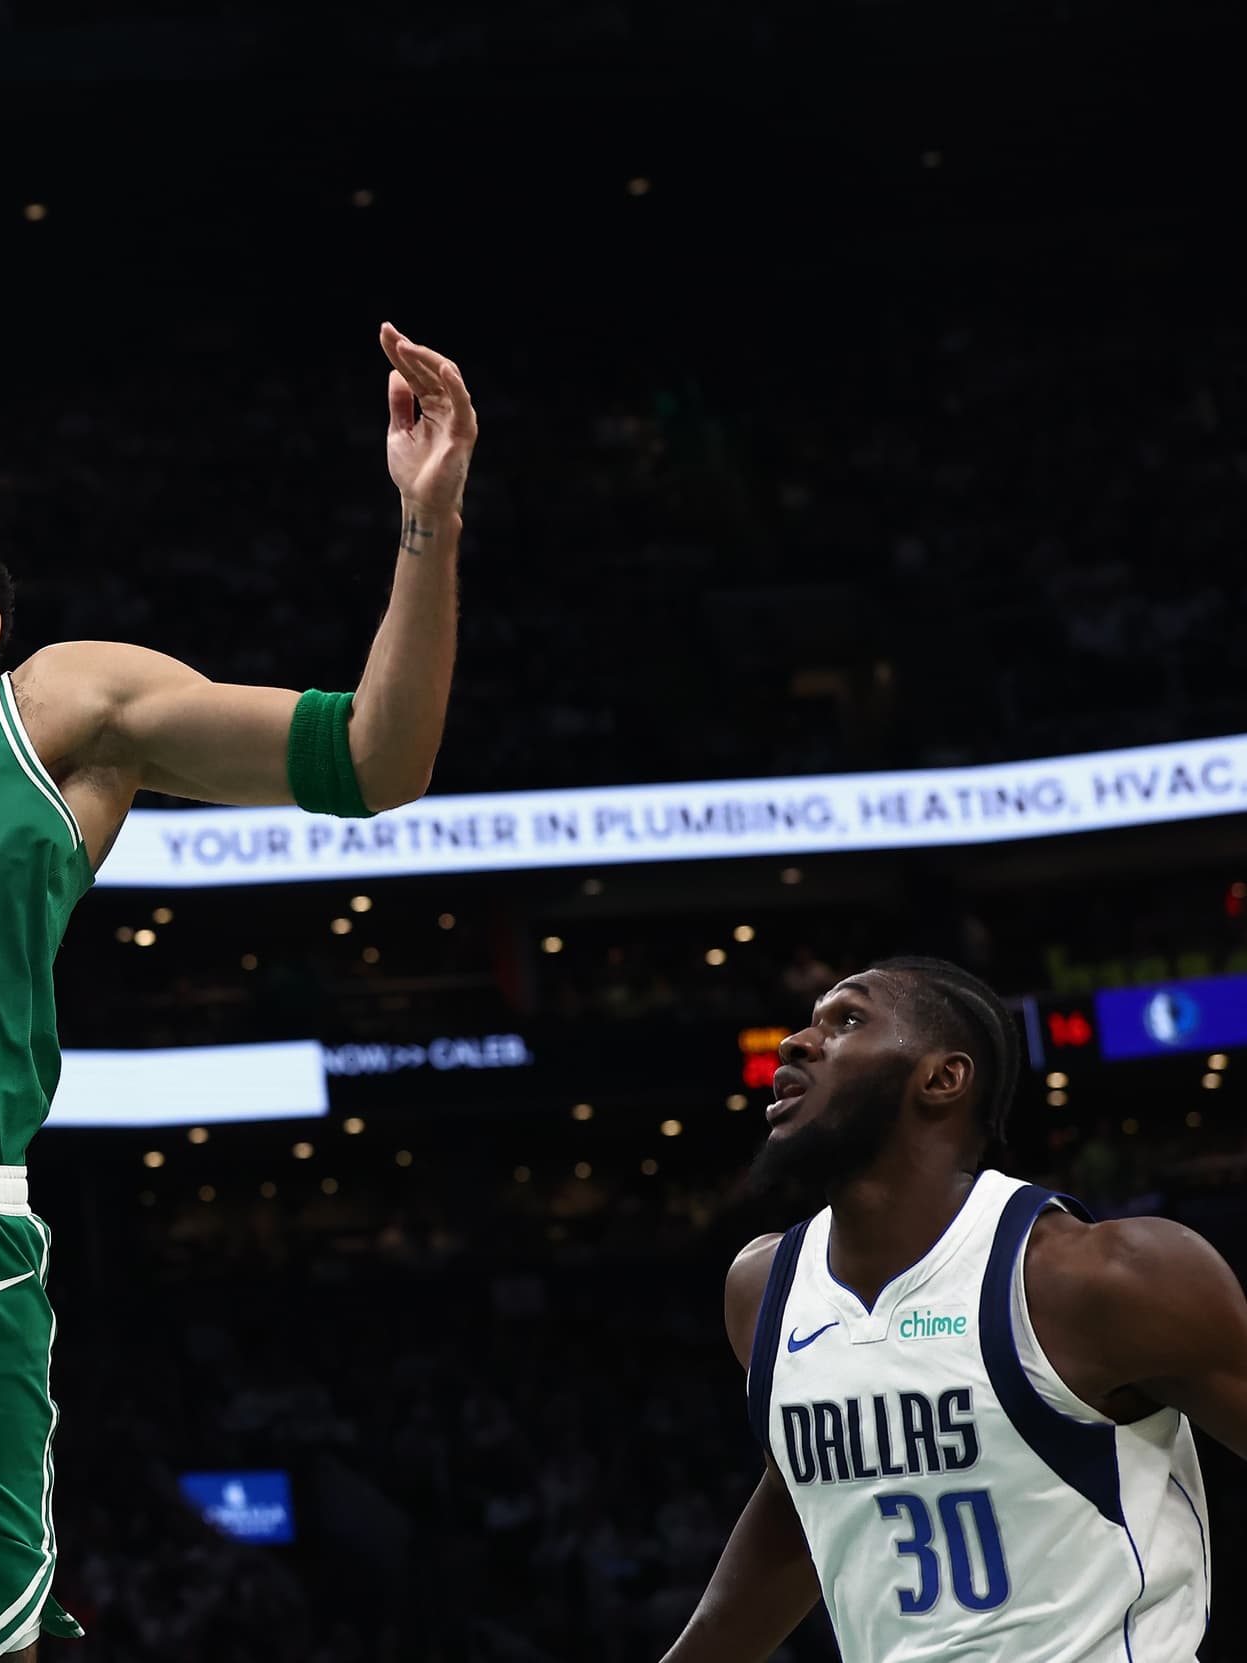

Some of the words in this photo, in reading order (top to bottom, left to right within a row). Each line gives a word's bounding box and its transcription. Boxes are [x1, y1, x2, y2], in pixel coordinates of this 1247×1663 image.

[161, 826, 293, 866] YOUR
[308, 812, 517, 858] PARTNER
[533, 807, 577, 843] IN
[595, 794, 848, 841] PLUMBING,
[859, 777, 1082, 825] HEATING,
[900, 1310, 967, 1338] chime
[780, 1386, 982, 1486] DALLAS
[873, 1488, 1011, 1616] 30
